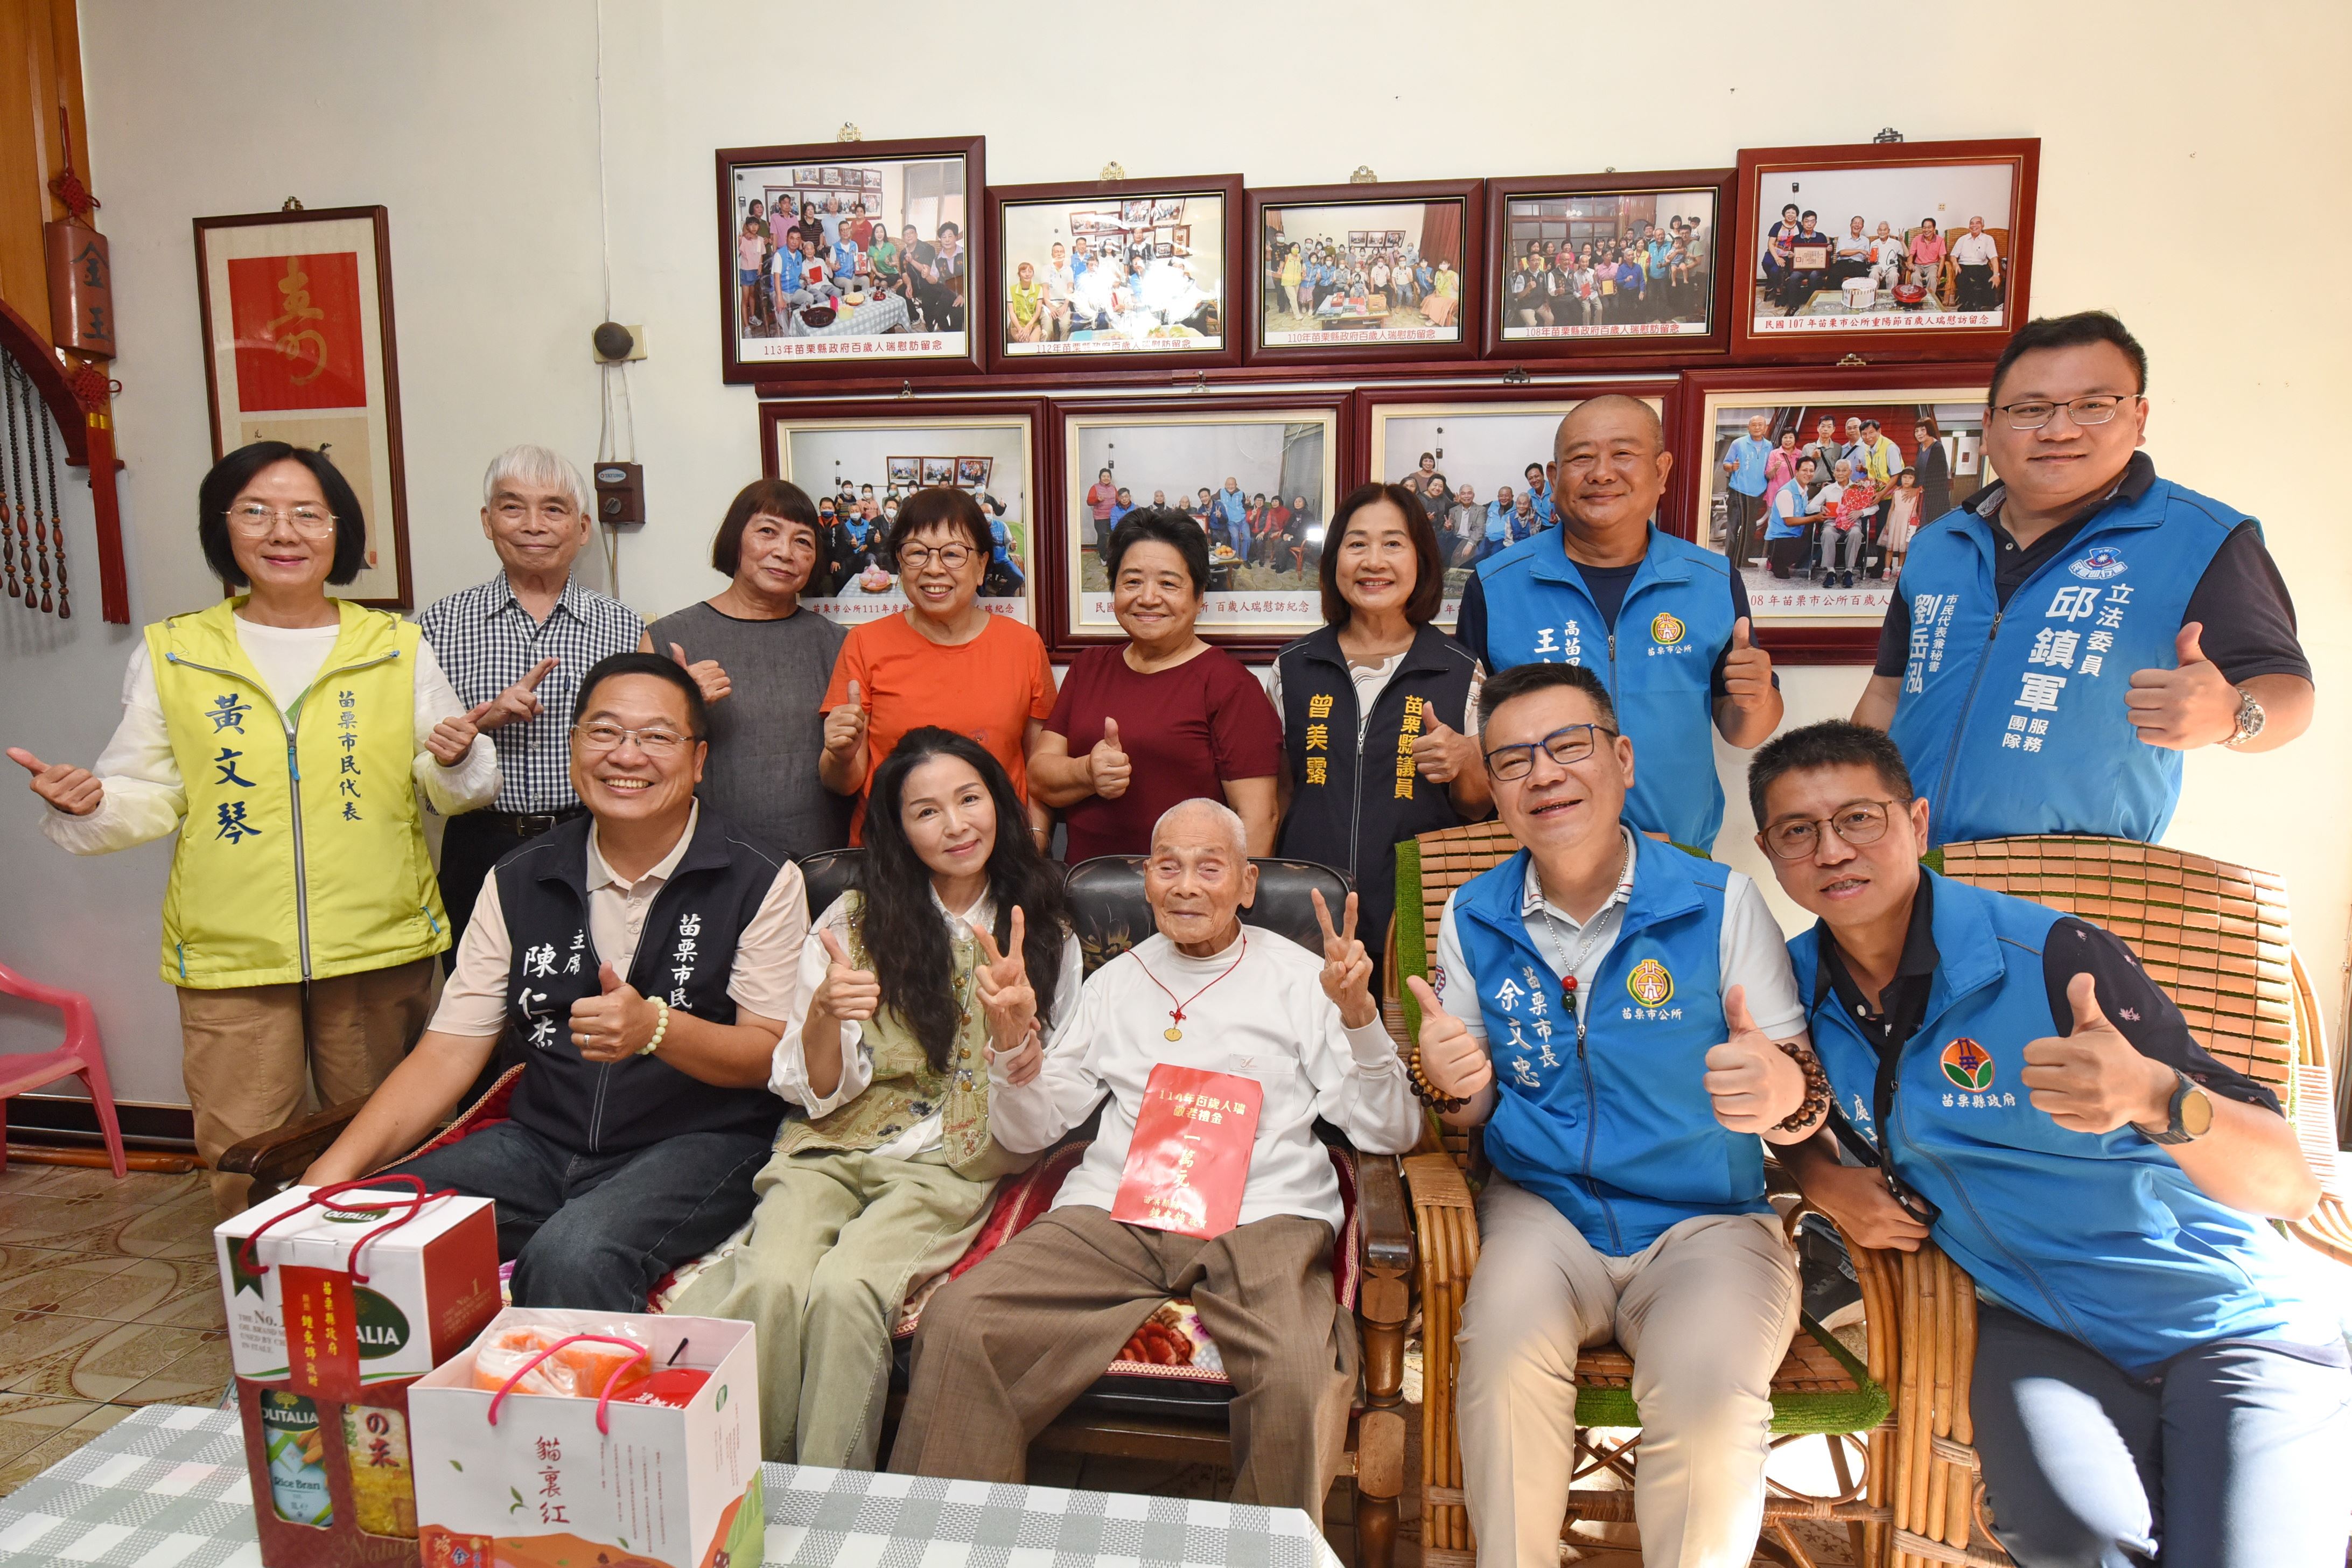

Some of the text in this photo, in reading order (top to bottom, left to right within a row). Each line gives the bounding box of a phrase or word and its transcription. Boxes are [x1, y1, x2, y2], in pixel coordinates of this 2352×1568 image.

[1287, 330, 1436, 343] 110年苗栗縣政府百歲人瑞慰訪留念
[1525, 324, 1679, 337] 108年苗栗縣政府百歲人瑞慰訪留念
[1808, 314, 1990, 328] 年苗栗市公所重陽節百歲人瑞慰訪留念
[764, 340, 943, 355] 113年苗栗縣政府百歲人瑞慰訪留念
[976, 603, 1014, 613] 瑞紀念
[1215, 600, 1310, 613] 百歲人瑞慰訪紀念
[1768, 594, 1889, 607] 年苗栗市公所百歲人
[1647, 644, 1692, 656] 苗栗市公所
[1906, 594, 1943, 694] 劉岳泓
[1928, 594, 1959, 673] 市民代表兼秘書
[2013, 585, 2102, 712] 邱鎮軍
[2077, 583, 2134, 677] 立法委員
[1305, 693, 1334, 786] 曾美露
[1394, 695, 1424, 800] 苗栗縣議員
[2001, 715, 2027, 749] 團隊
[2022, 718, 2049, 753] 服務
[205, 693, 263, 845] 黃文琴
[338, 690, 363, 821] 苗栗市民代表
[563, 929, 586, 976] 主席
[669, 913, 702, 1013] 苗栗市民
[518, 942, 558, 1048] 陳仁杰
[1622, 1007, 1683, 1021] 苗栗市公所
[1494, 978, 1541, 1088] 余文忠
[1522, 965, 1560, 1068] 苗栗市長
[1159, 1089, 1246, 1116] 114年百歲人瑞
[1173, 1104, 1223, 1125] 敬老禮金
[1942, 1092, 2017, 1108] 苗栗縣政府
[1173, 1134, 1201, 1188] 一萬元
